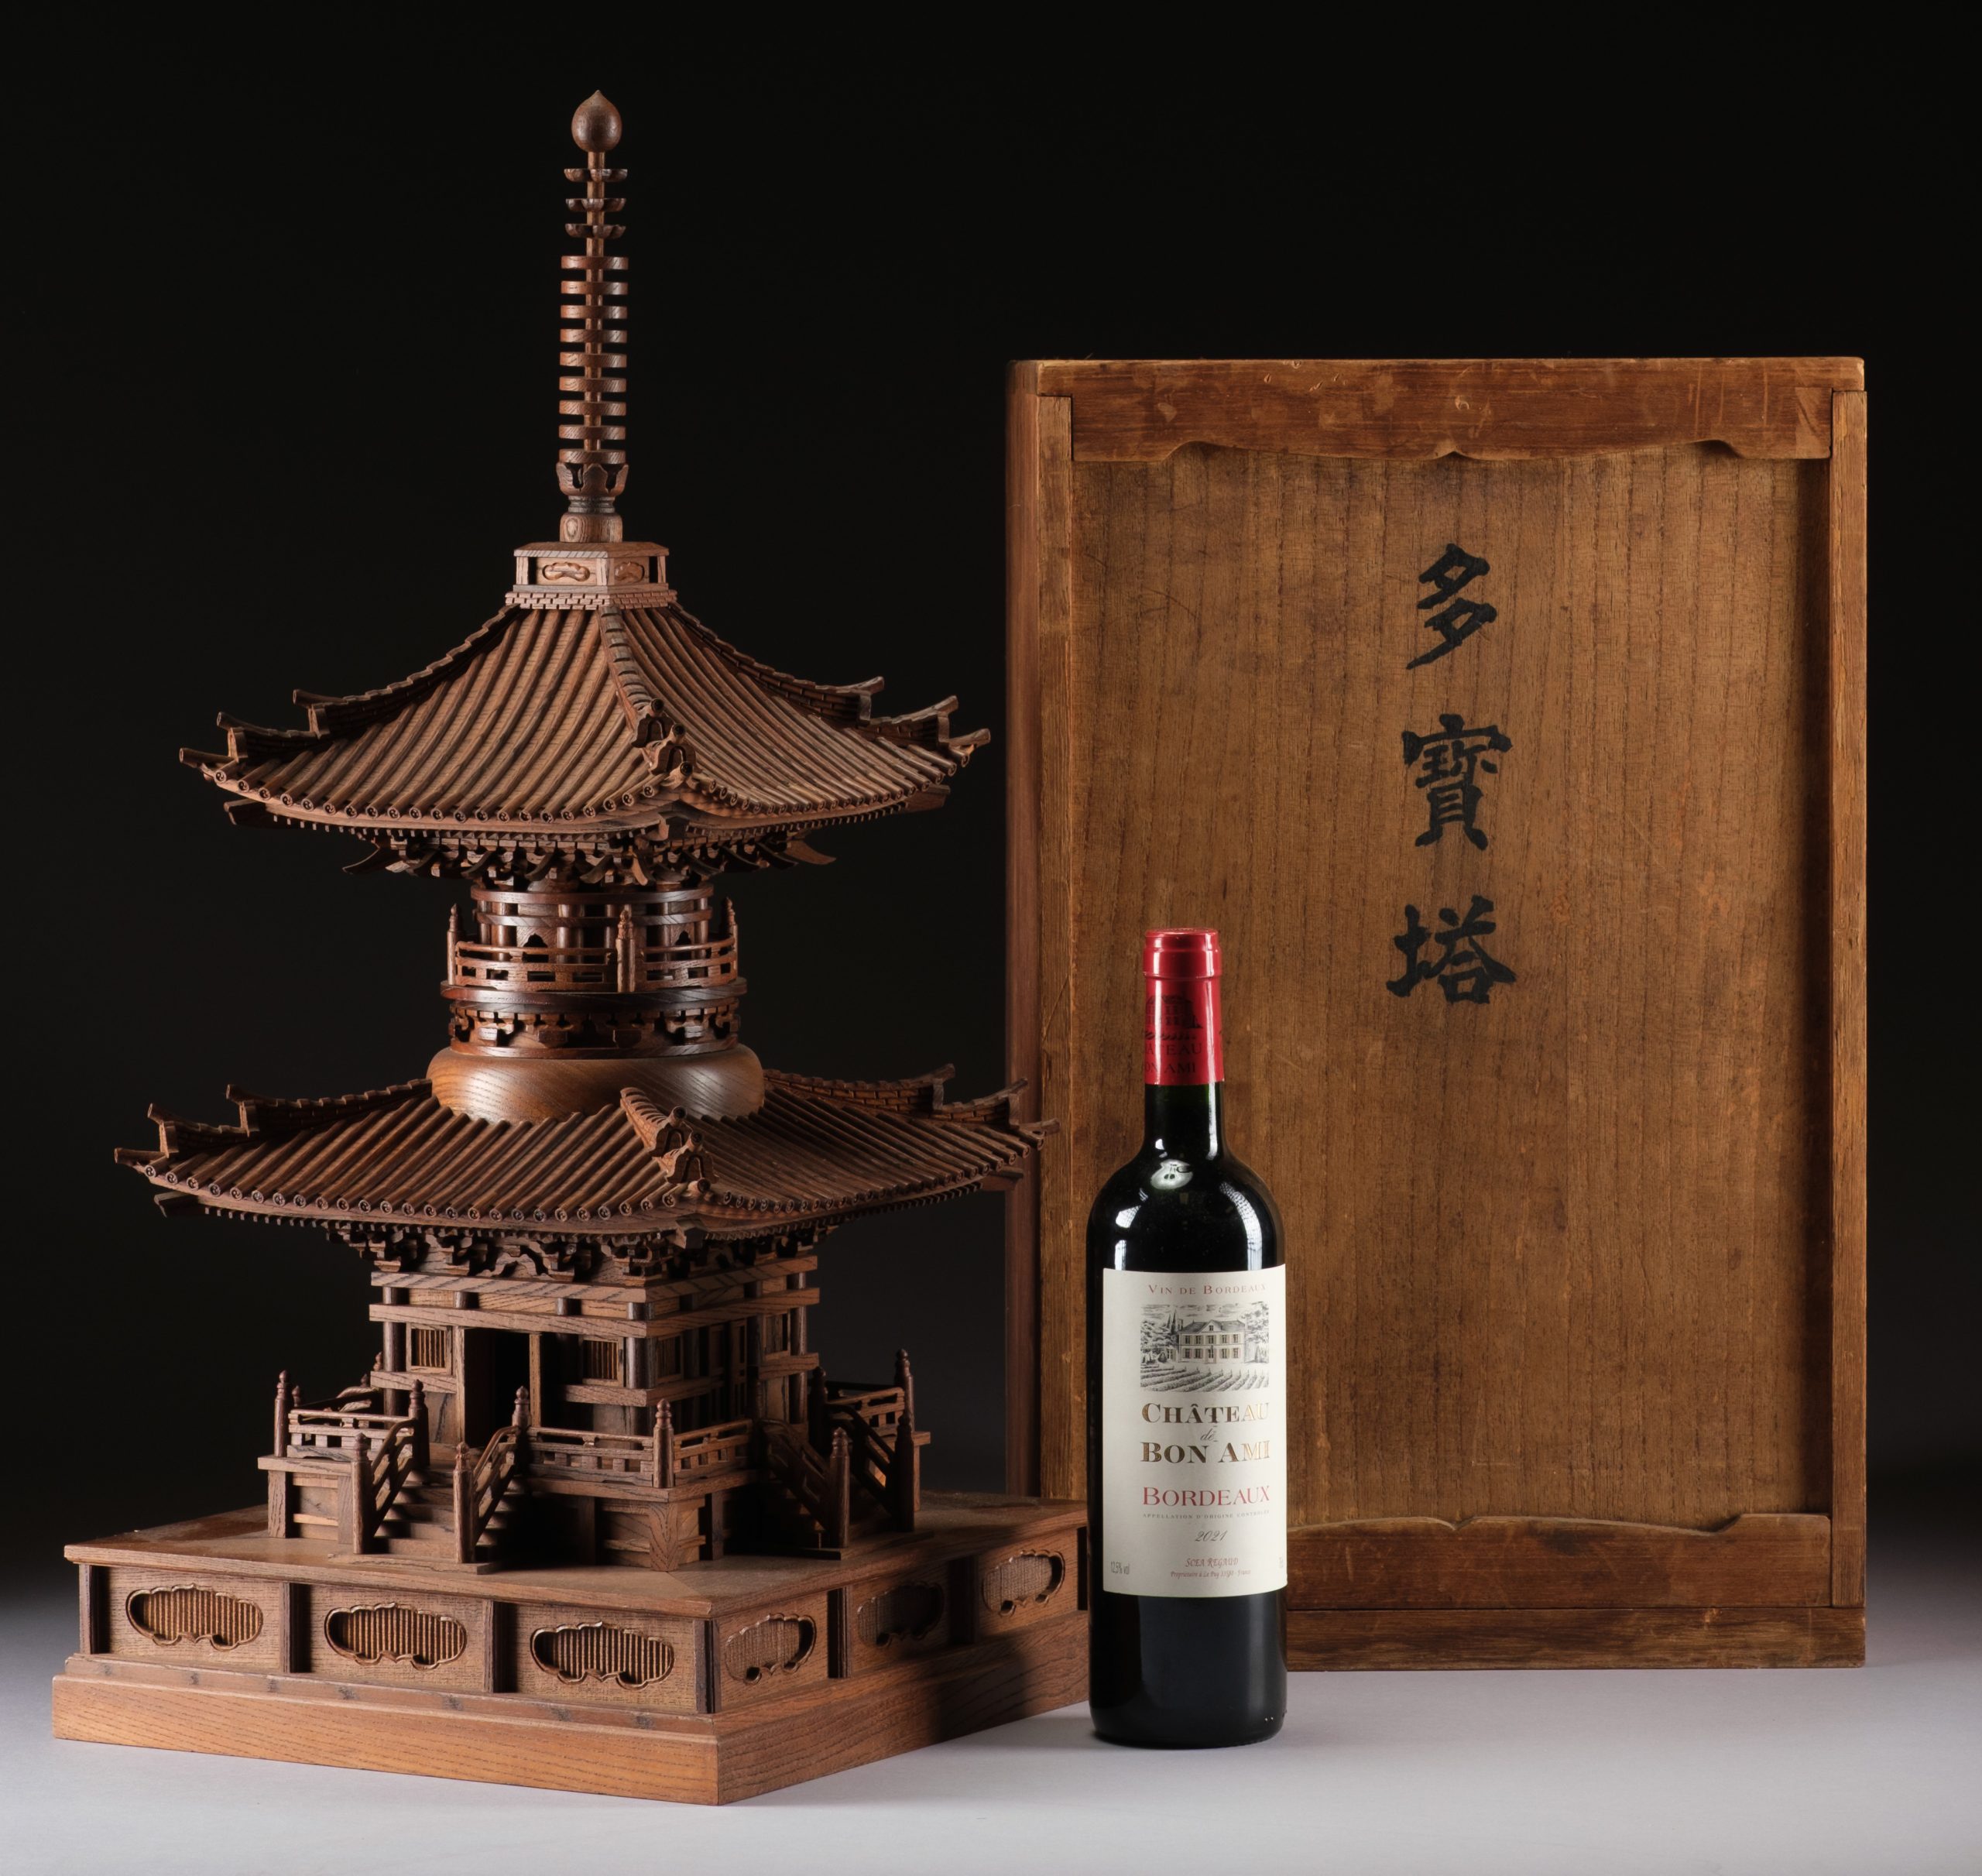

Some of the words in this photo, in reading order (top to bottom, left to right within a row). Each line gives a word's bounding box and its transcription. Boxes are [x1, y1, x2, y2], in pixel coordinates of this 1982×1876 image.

[1387, 544, 1517, 1004] 多寶塔
[1141, 1402, 1270, 1424] CHÂTEAU
[1140, 1441, 1209, 1464] BON
[1218, 1440, 1270, 1463] AMI
[1143, 1485, 1270, 1507] BORDEAUX
[1195, 1530, 1228, 1542] 2021
